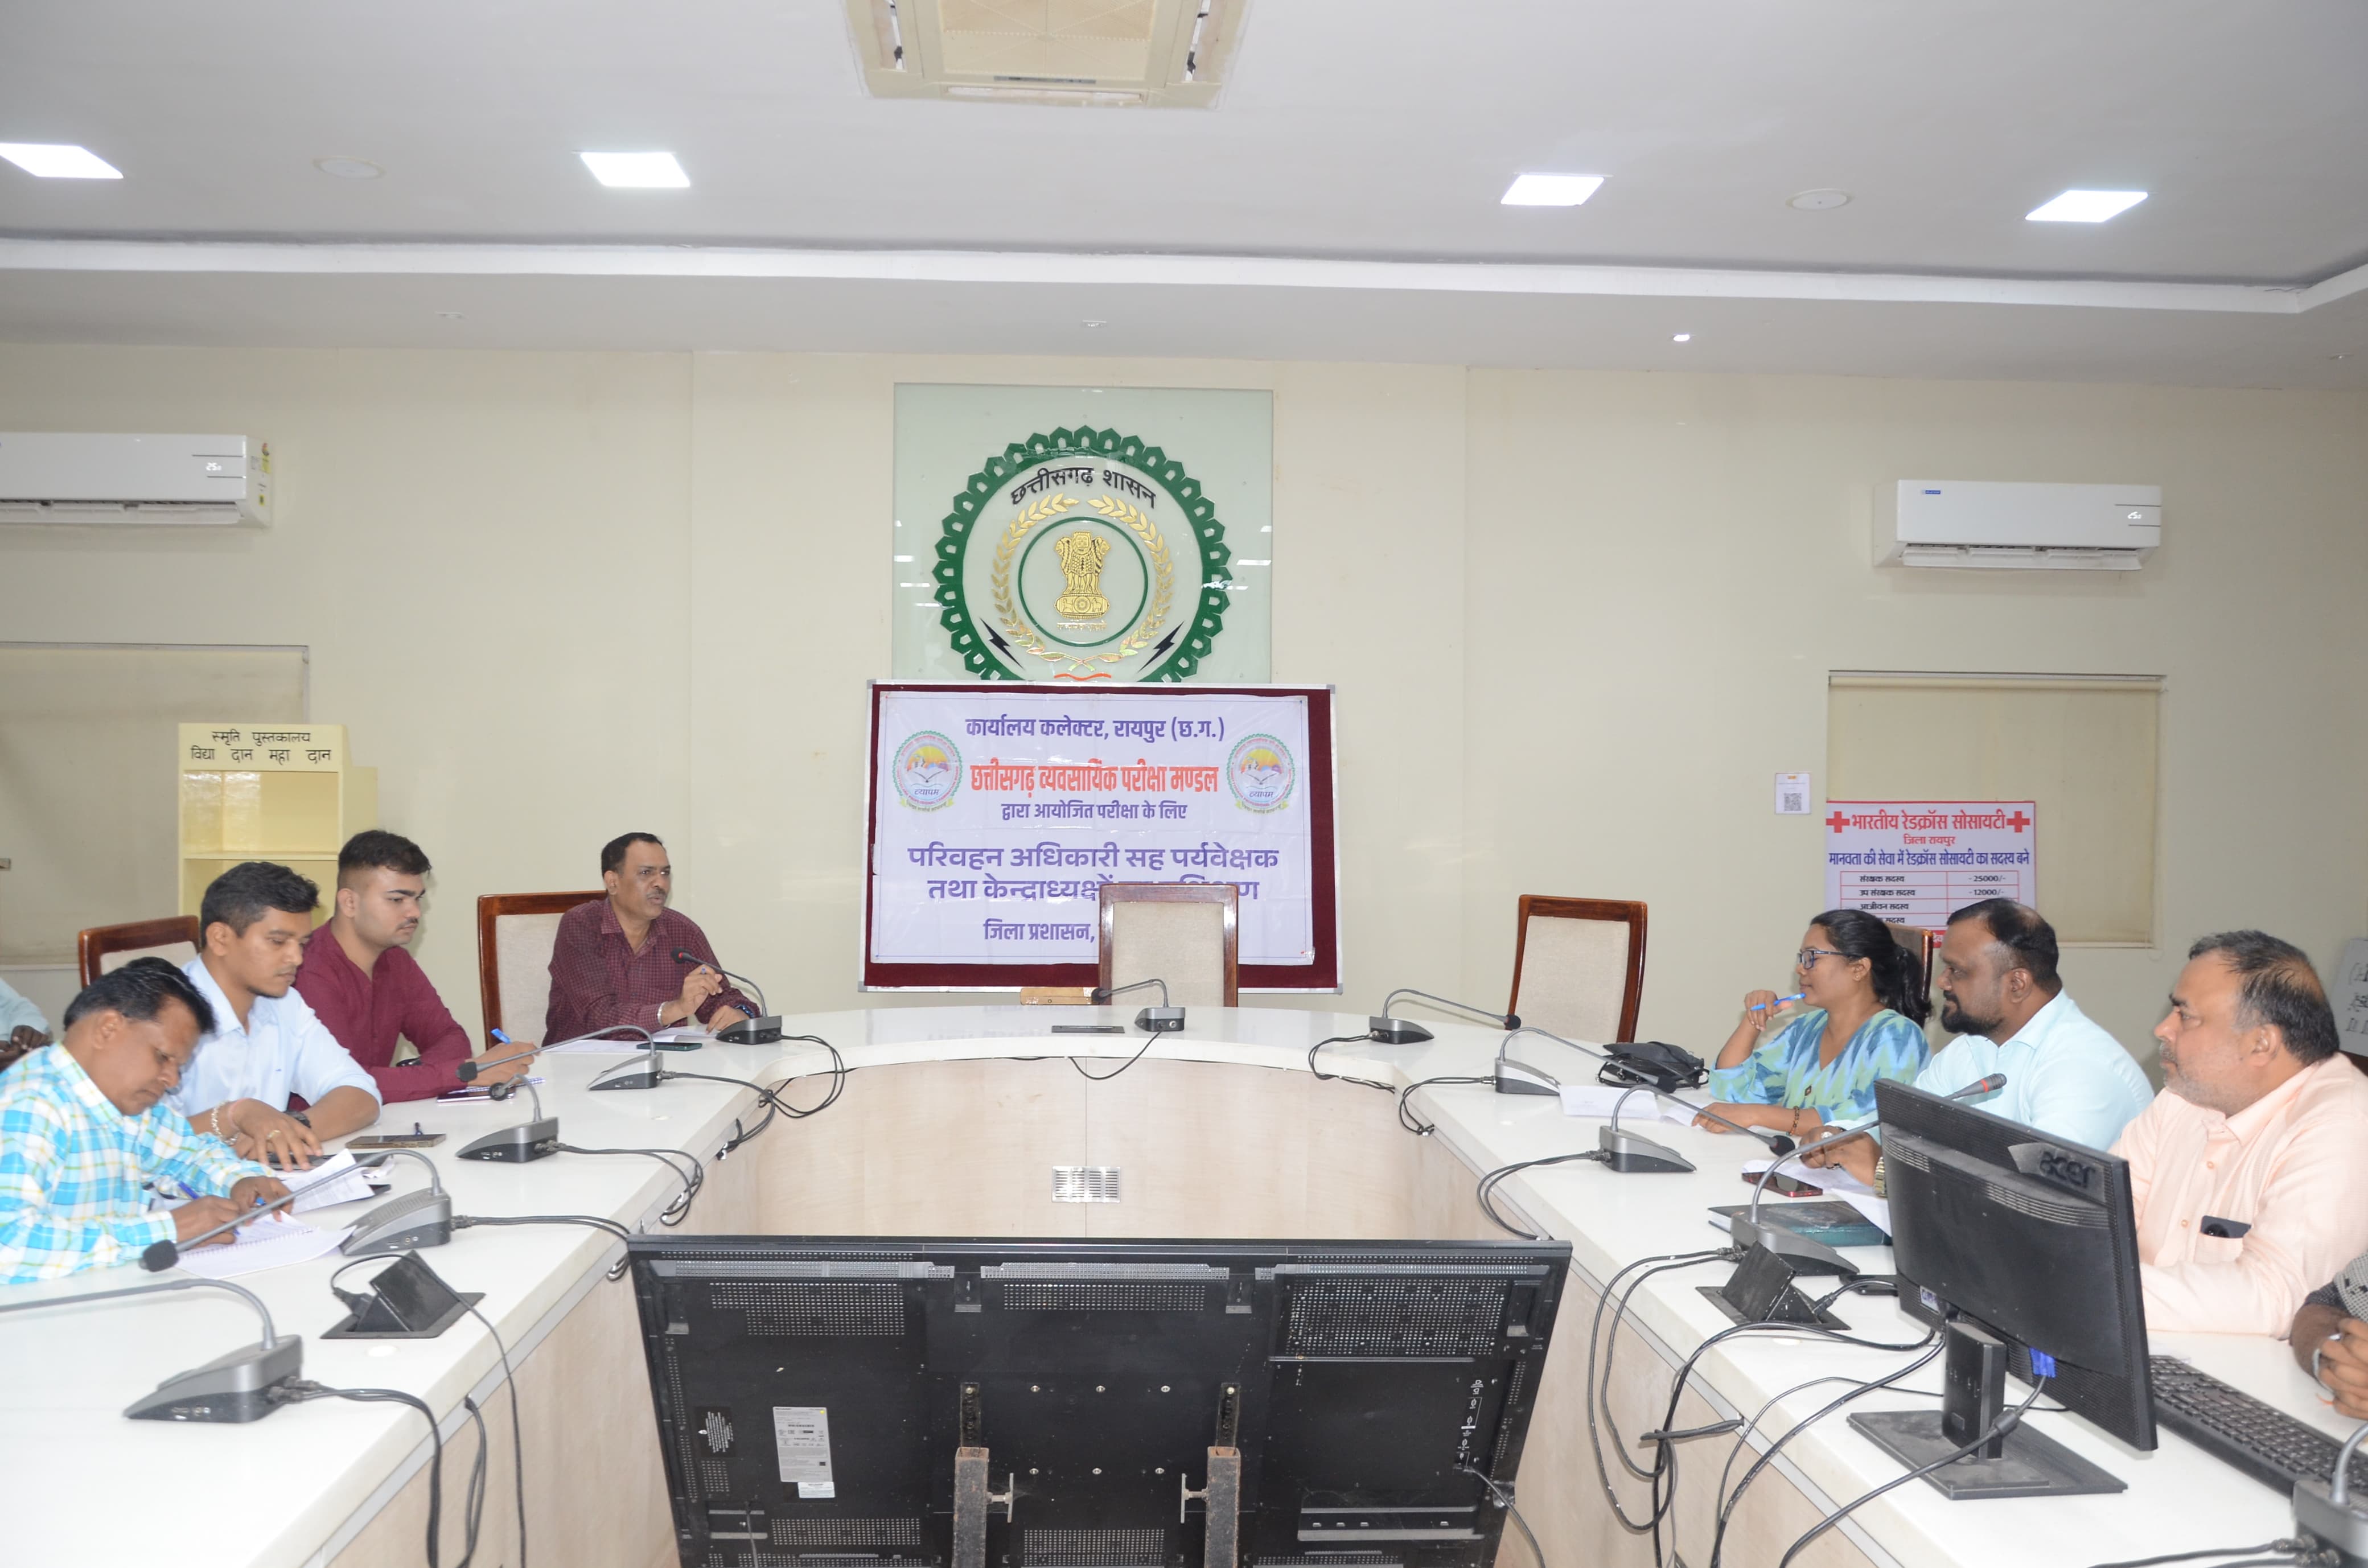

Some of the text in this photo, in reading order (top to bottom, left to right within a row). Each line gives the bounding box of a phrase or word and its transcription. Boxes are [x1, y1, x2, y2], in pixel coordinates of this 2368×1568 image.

[1011, 467, 1156, 508] छत्तीसगढ़ शासन
[212, 729, 311, 747] स्मृति पुस्तकालय
[965, 714, 1224, 743] कार्यालय कलेक्टर, रायपुर (छ.ग.)
[190, 745, 331, 765] विद्या दान महा दान
[970, 757, 1036, 798] छत्तीसगढ़
[1121, 758, 1167, 792] परीक्षा
[1170, 766, 1219, 792] मण्डल
[1001, 800, 1188, 820] द्वारा आयोजित परीक्षा के लिए
[1852, 809, 2007, 830] भारतीय रेडक्रॉस सोसायटी
[1903, 834, 1956, 846] जिला रायपुर
[907, 841, 1280, 870] परिवहन अधिकारी सह पर्यवेक्षक
[1829, 848, 2029, 866] मानवता की सेवा में रेडक्रॉस सोसायटी का सदस्य बने
[927, 880, 977, 899] तथा
[1859, 901, 1888, 911] आजीवन
[983, 918, 1095, 943] जिला प्रशासन,
[2041, 1151, 2096, 1188] acer
